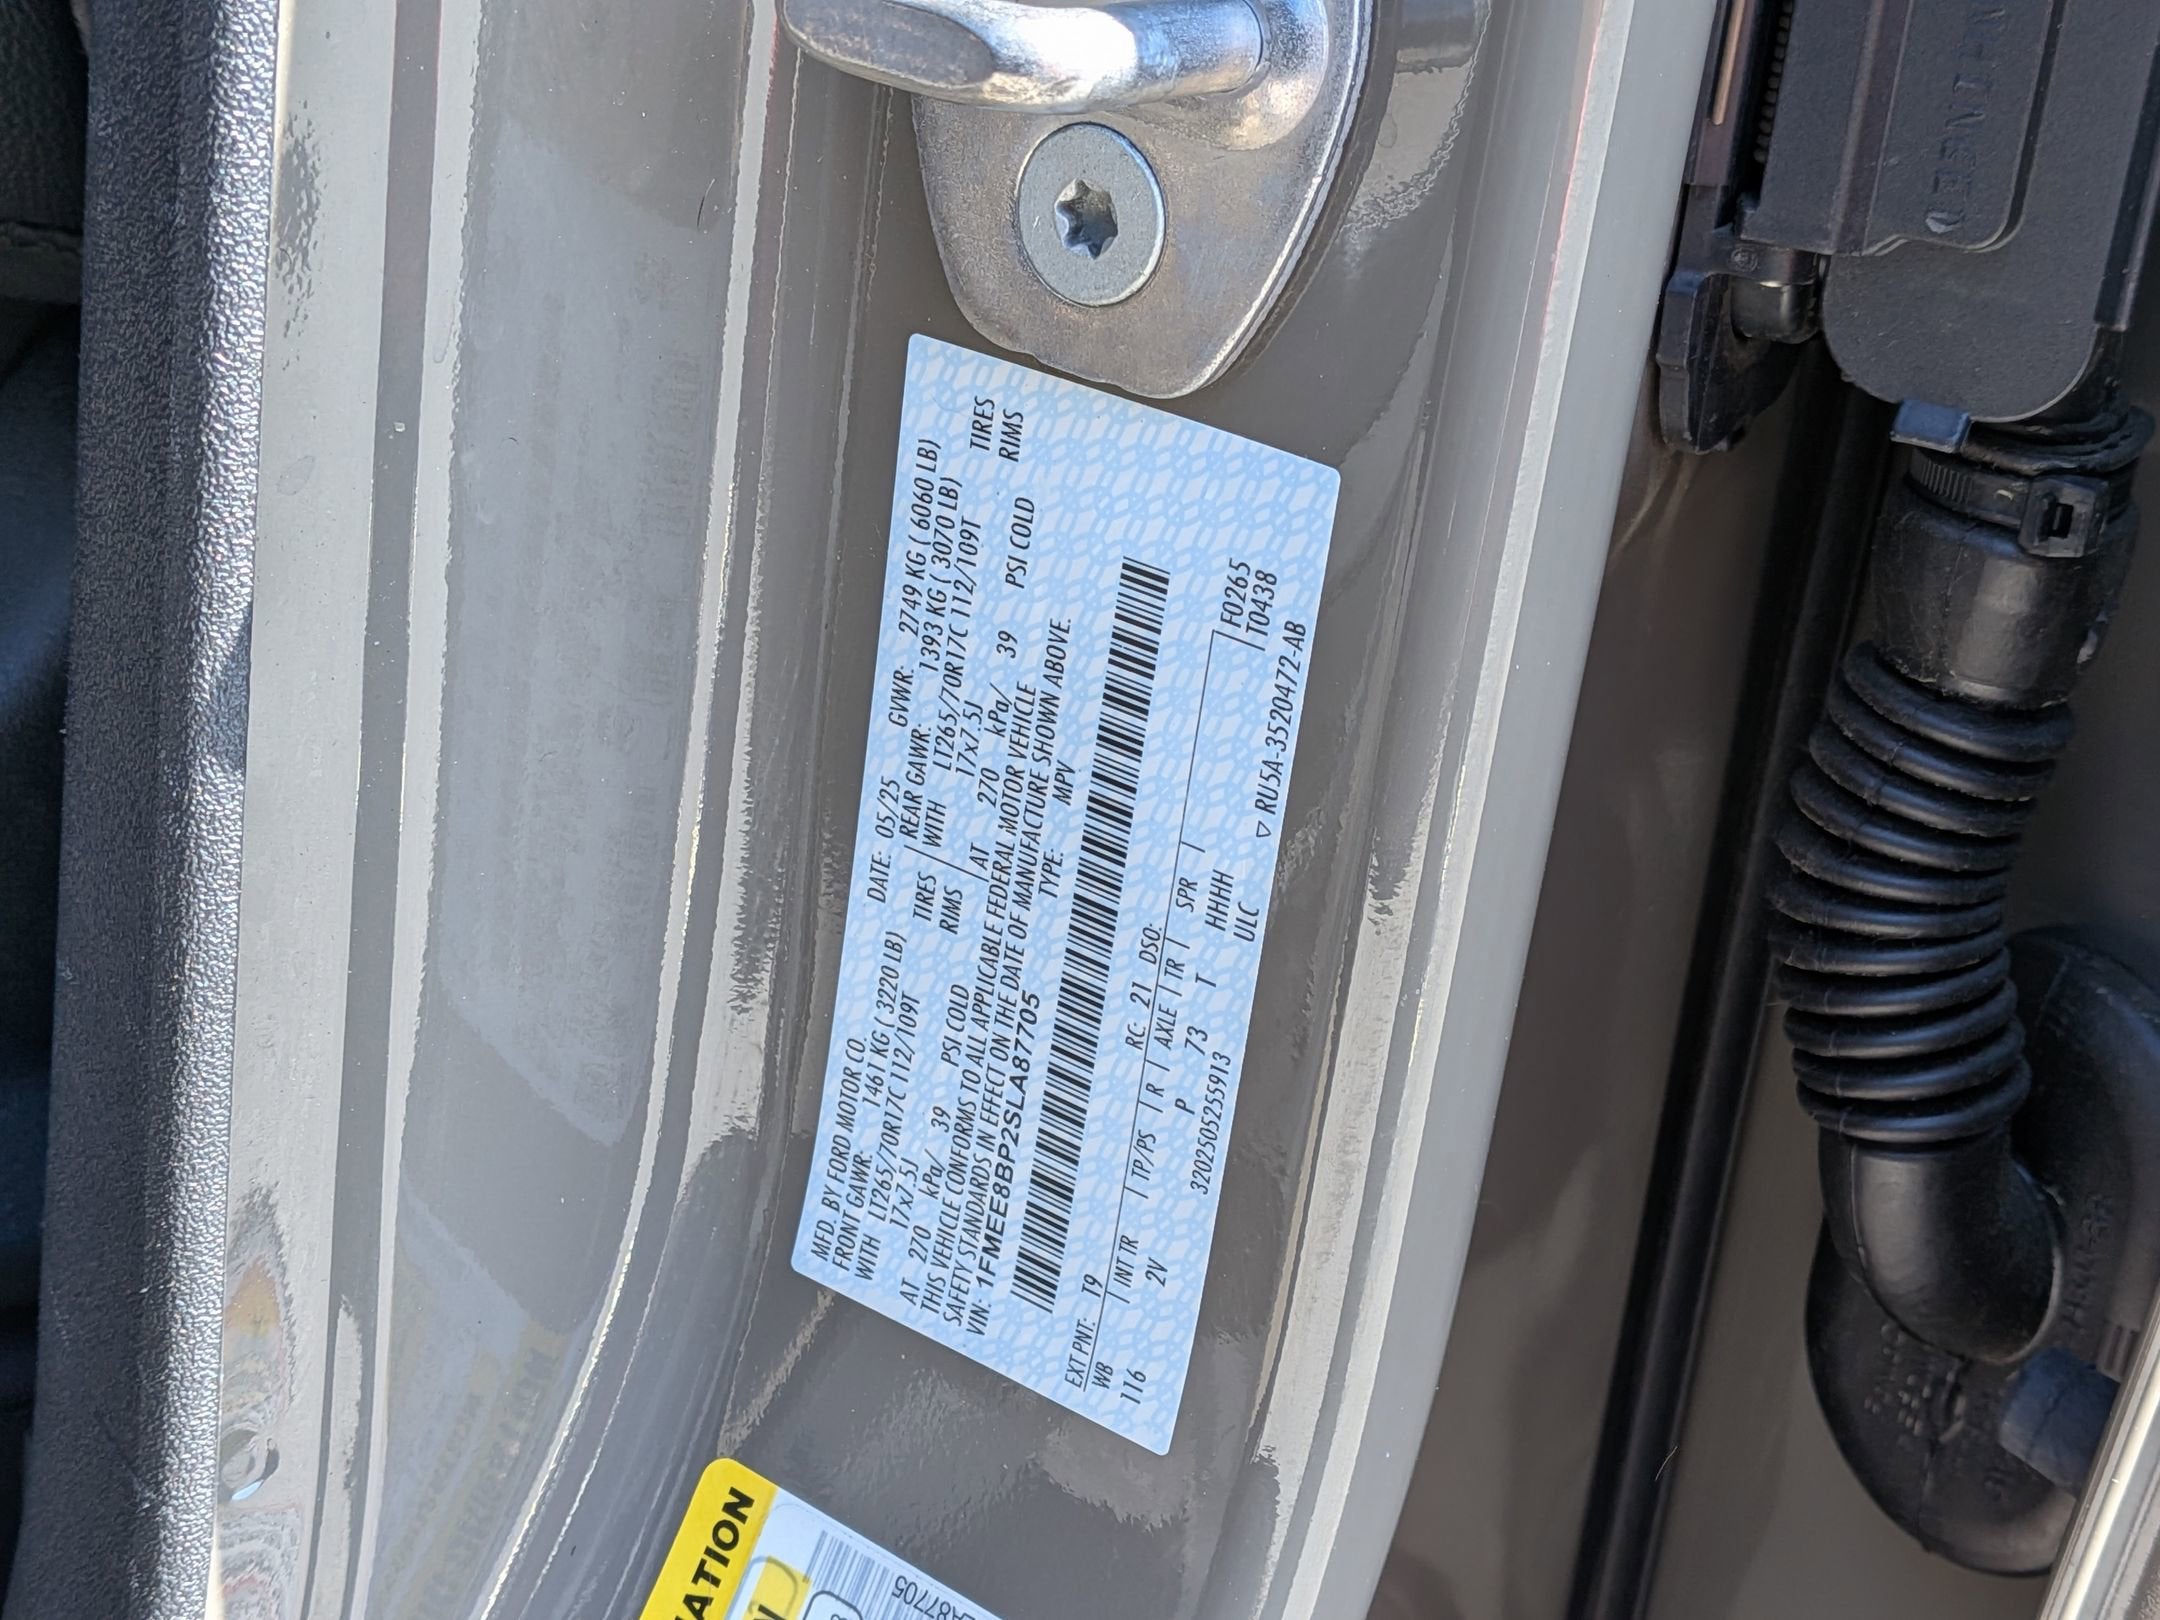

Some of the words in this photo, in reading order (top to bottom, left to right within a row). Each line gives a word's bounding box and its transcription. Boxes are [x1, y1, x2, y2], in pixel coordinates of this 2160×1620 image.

[968, 395, 996, 452] TIRES
[997, 407, 1025, 464] RIMS
[914, 438, 943, 474] LB)
[909, 476, 936, 532] 6060
[936, 476, 964, 512] LB)
[929, 513, 957, 570] 3070
[1008, 496, 1036, 551] COLD
[904, 549, 928, 582] KG
[949, 514, 982, 619] 112/109T
[1004, 553, 1029, 590] PSI
[897, 583, 924, 638] 2749
[924, 586, 948, 619] KG
[1219, 557, 1252, 630] F0265
[1244, 568, 1279, 638] T0438
[917, 620, 945, 673] 1393
[995, 629, 1019, 660] 39
[1041, 618, 1072, 690] ABOVE.
[887, 665, 915, 729] GVWR:
[931, 622, 969, 772] LT265/70R17C
[982, 681, 1014, 739] kPa/
[1006, 680, 1037, 761] VEHICLE
[1253, 619, 1307, 816] RU5A-3520472-AB
[954, 699, 985, 778] 17x7.5J
[1030, 689, 1061, 768] SHOWN
[904, 726, 932, 787] GAWR:
[873, 774, 901, 840] 05/25
[976, 766, 1001, 809] 270
[996, 763, 1026, 838] MOTOR
[1050, 758, 1077, 807] MPV
[898, 789, 924, 841] REAR
[921, 798, 948, 849] WITH
[1010, 767, 1051, 913] MANUFACTURE
[865, 853, 893, 905] DATE:
[967, 841, 991, 872] AT
[985, 840, 1017, 921] FEDERAL
[1037, 850, 1065, 899] TYPE:
[911, 870, 938, 923] TIRES
[938, 884, 964, 936] RIMS
[1174, 876, 1199, 914] SPR
[1203, 868, 1235, 933] HHHH
[882, 930, 908, 964] LB)
[1006, 910, 1030, 941] OF
[1137, 922, 1162, 966] DSO:
[1232, 900, 1261, 943] ULC
[874, 964, 901, 1016] 3220
[969, 919, 1004, 1033] APPLICABLE
[998, 940, 1026, 993] DATE
[1162, 956, 1186, 981] TR
[1193, 971, 1218, 989] T
[944, 983, 971, 1034] COLD
[992, 990, 1018, 1030] THE
[1128, 980, 1153, 1010] 21
[844, 1037, 868, 1065] CO.
[868, 1029, 891, 1060] KG
[889, 989, 921, 1084] 112/109T
[939, 1034, 963, 1069] PSI
[964, 1034, 989, 1070] ALL
[988, 1030, 1012, 1063] ON
[1124, 1021, 1147, 1052] RC:
[1152, 1002, 1179, 1051] AXLE
[1183, 1024, 1209, 1057] 73
[834, 1065, 863, 1134] MOTOR
[861, 1060, 887, 1109] 1461
[958, 1067, 982, 1096] TO
[978, 1061, 1007, 1128] EFFECT
[1144, 1081, 1166, 1099] R
[1173, 1096, 1196, 1116] P
[929, 1105, 952, 1134] 39
[974, 988, 1041, 1289] 1FMEE8BP2SLA87705
[974, 1127, 997, 1154] IN
[1189, 1050, 1232, 1196] 3202505255913
[825, 1133, 852, 1186] FORD
[866, 1084, 908, 1225] LT265/70R17C
[943, 1095, 978, 1197] CONFORMS
[1130, 1128, 1158, 1182] TP/PS
[820, 1183, 843, 1214] BY
[844, 1150, 874, 1210] GAWR:
[888, 1156, 920, 1231] 17x7.5J
[917, 1147, 947, 1201] kPa/
[956, 1152, 993, 1262] STANDARDS
[809, 1218, 838, 1263] MFD.
[831, 1208, 862, 1273] FRONT
[853, 1232, 882, 1282] WITH
[906, 1224, 933, 1265] 270
[929, 1196, 962, 1271] VEHICLE
[1117, 1233, 1140, 1257] TR
[898, 1276, 922, 1307] AT
[918, 1271, 948, 1315] THIS
[942, 1258, 974, 1328] SAFETY
[1080, 1272, 1104, 1299] T9
[1112, 1255, 1136, 1289] INT
[1144, 1256, 1169, 1288] 2V
[965, 1298, 993, 1337] VIN:
[1070, 1317, 1097, 1357] PNT:
[1063, 1352, 1088, 1390] EXT
[1090, 1360, 1115, 1390] WB
[1119, 1367, 1148, 1406] 116
[674, 1487, 755, 1620] ATION
